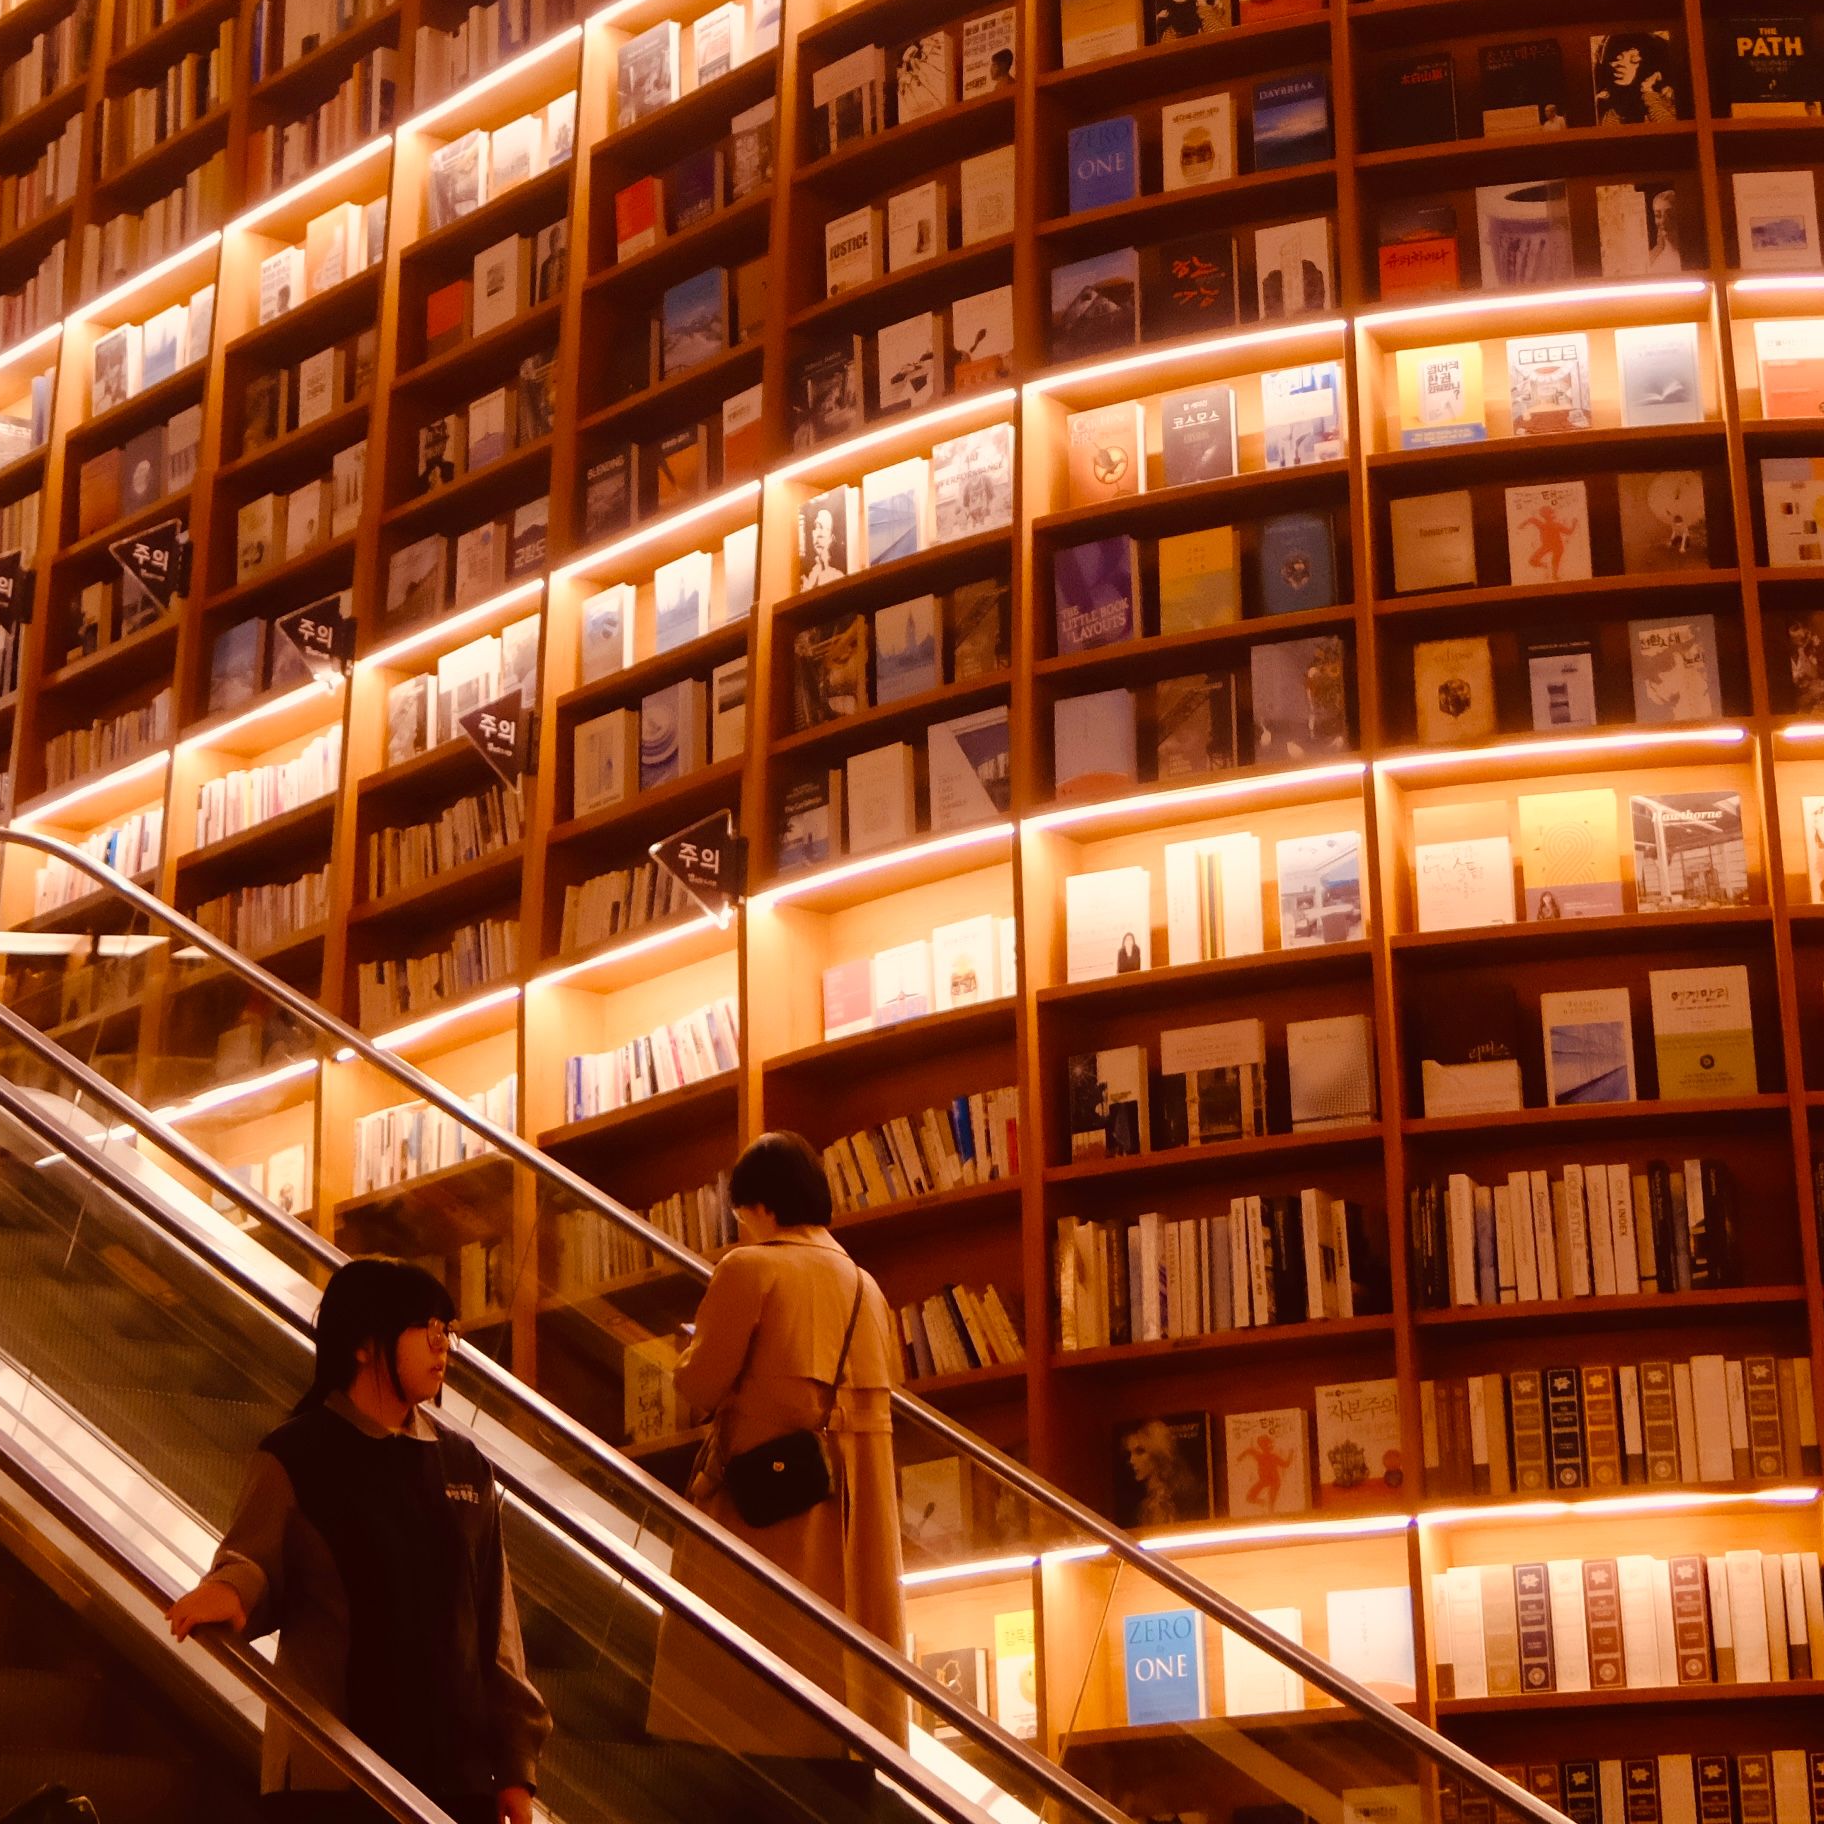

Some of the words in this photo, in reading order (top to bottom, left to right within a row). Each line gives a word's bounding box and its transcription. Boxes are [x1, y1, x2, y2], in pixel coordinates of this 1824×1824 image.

[1735, 36, 1804, 57] PATH
[1258, 81, 1315, 101] DAYBREAK
[1077, 153, 1127, 181] ONE
[828, 231, 869, 262] JUSTICE
[1173, 412, 1221, 430] 코스모스
[132, 543, 170, 572] 주의
[298, 618, 334, 649] 주의
[1072, 615, 1126, 643] LAYOUTS
[478, 713, 516, 746] 주의
[678, 843, 720, 875] 주의
[1127, 1615, 1193, 1646] ZERO
[1134, 1654, 1189, 1683] ONE
